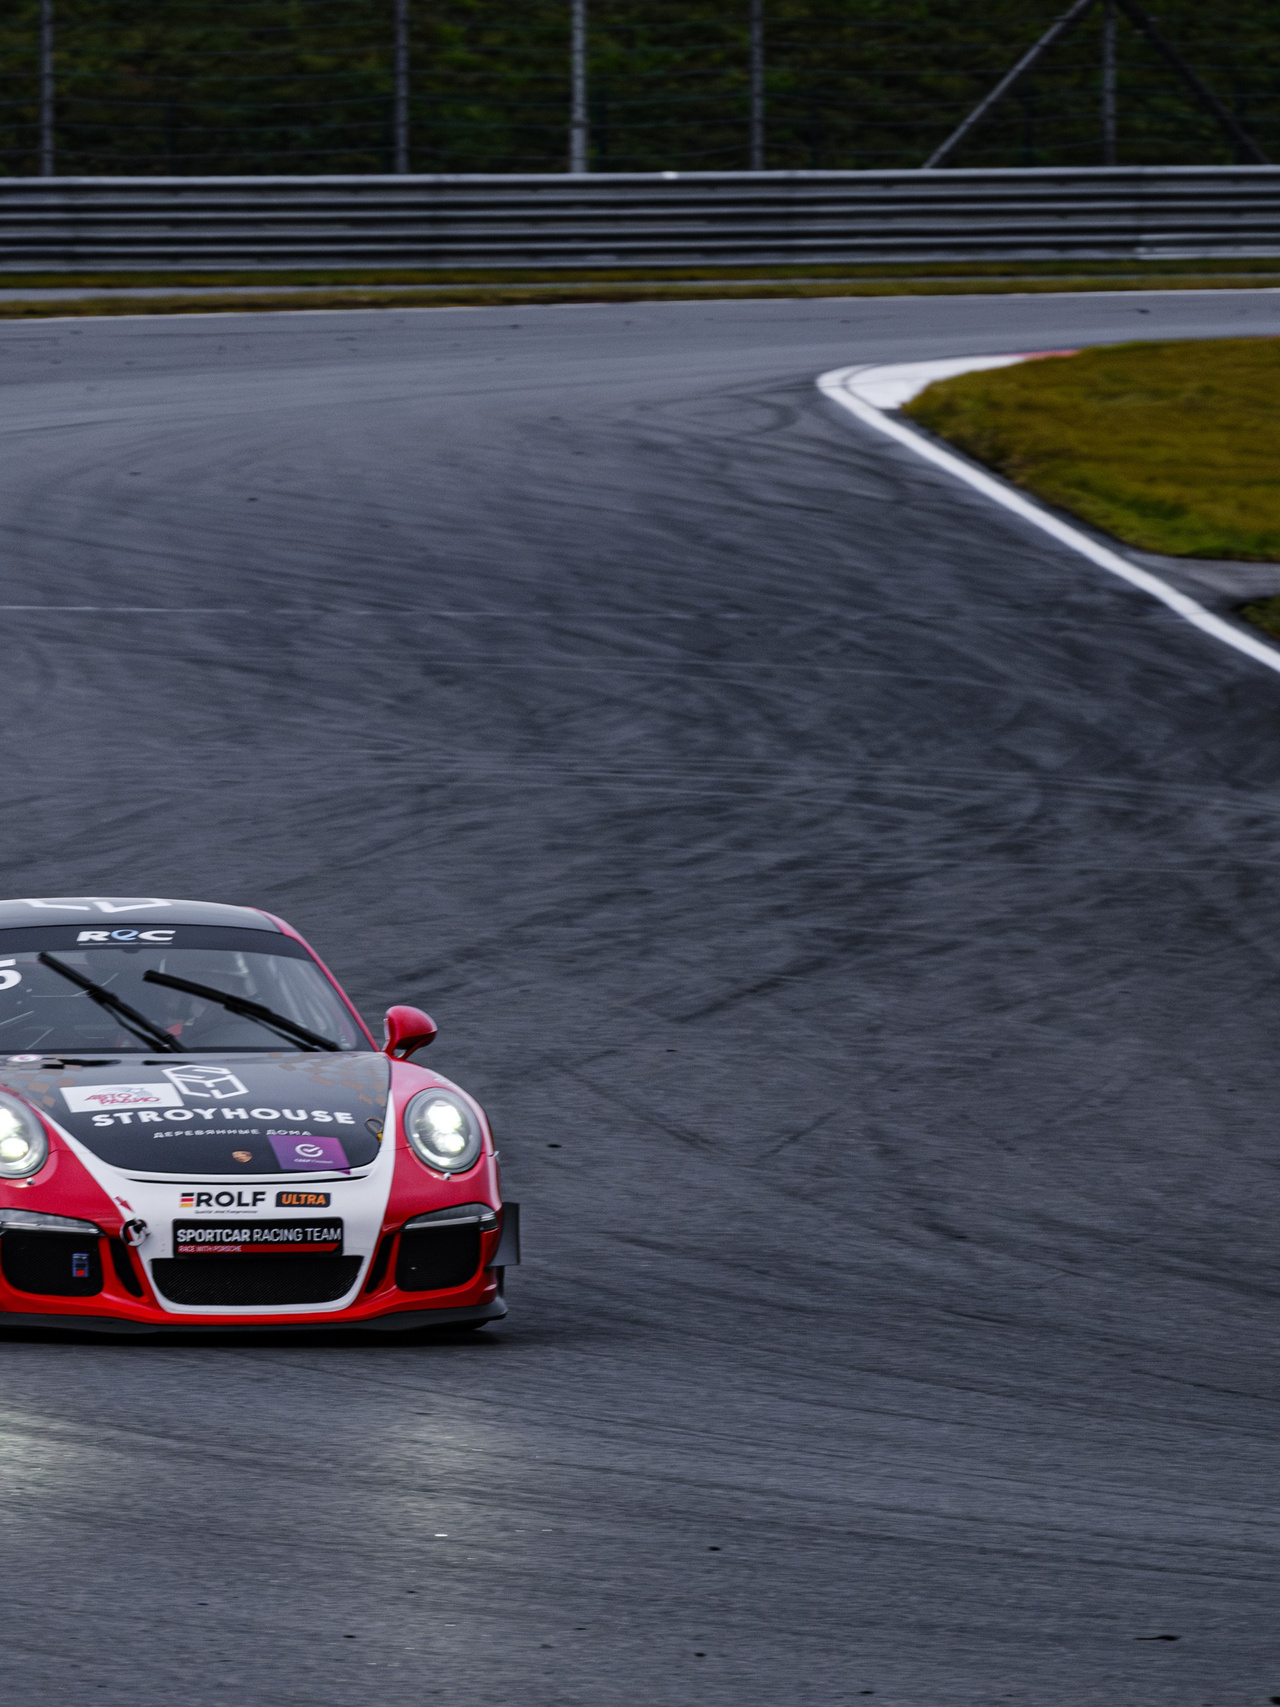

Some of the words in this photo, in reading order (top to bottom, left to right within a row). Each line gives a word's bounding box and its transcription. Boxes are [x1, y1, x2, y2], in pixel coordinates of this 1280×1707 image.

[91, 1107, 356, 1128] STROYHOUSE
[153, 1128, 260, 1139] ДЕРЕВЯННЫЕ
[266, 1129, 312, 1137] ДОМА
[195, 1191, 267, 1208] ROLF
[281, 1193, 327, 1206] ULTRA
[176, 1228, 251, 1243] SPORTCAR
[253, 1228, 303, 1242] RACING
[304, 1227, 342, 1241] TEAM
